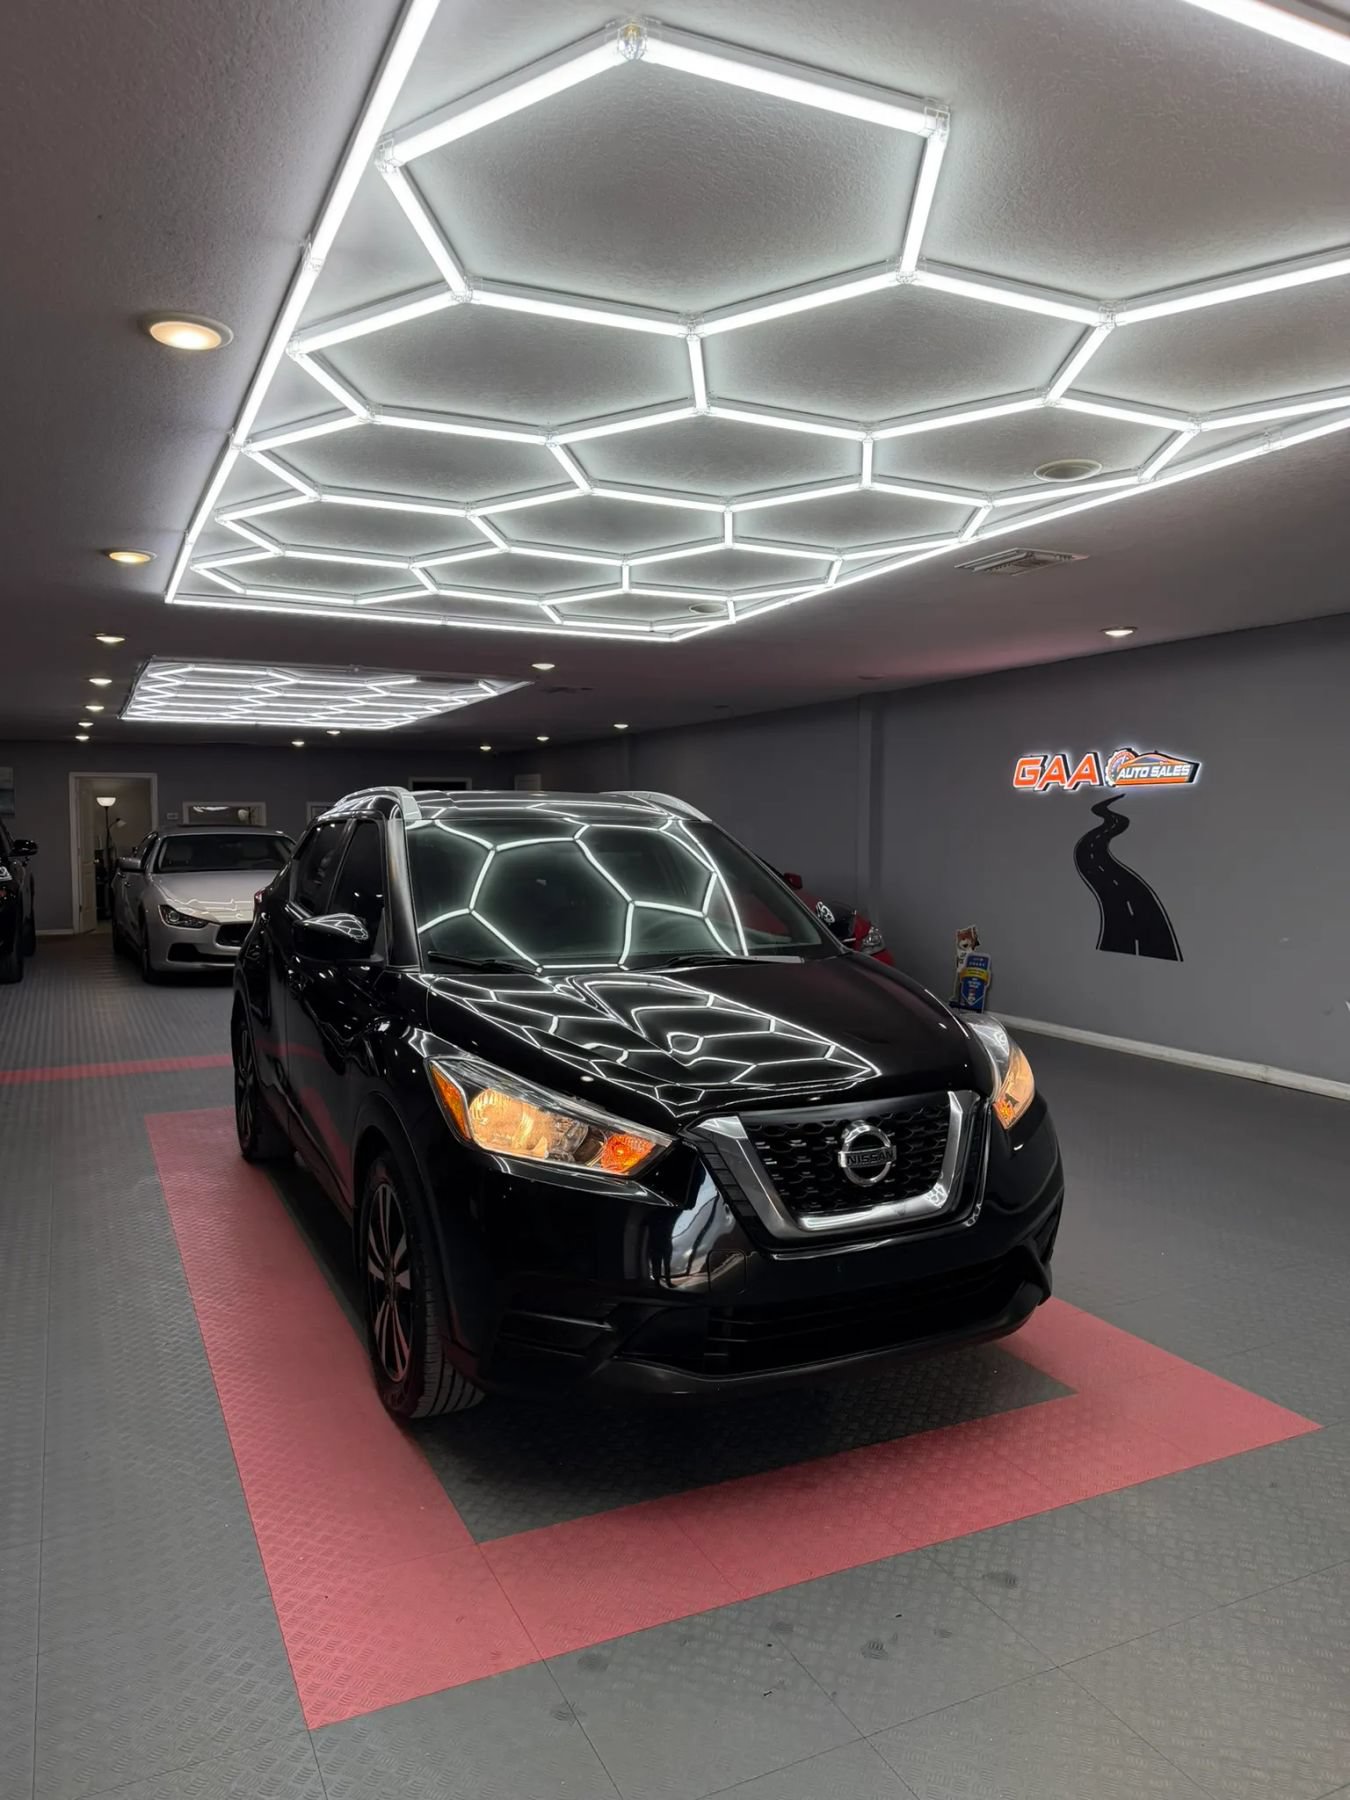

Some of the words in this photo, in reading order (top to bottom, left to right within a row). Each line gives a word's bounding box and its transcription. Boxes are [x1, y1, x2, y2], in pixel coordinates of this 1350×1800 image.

[1013, 752, 1101, 791] GAA
[1119, 766, 1150, 779] AUTO
[1150, 764, 1191, 778] SALES
[847, 1147, 893, 1166] NISSAN
